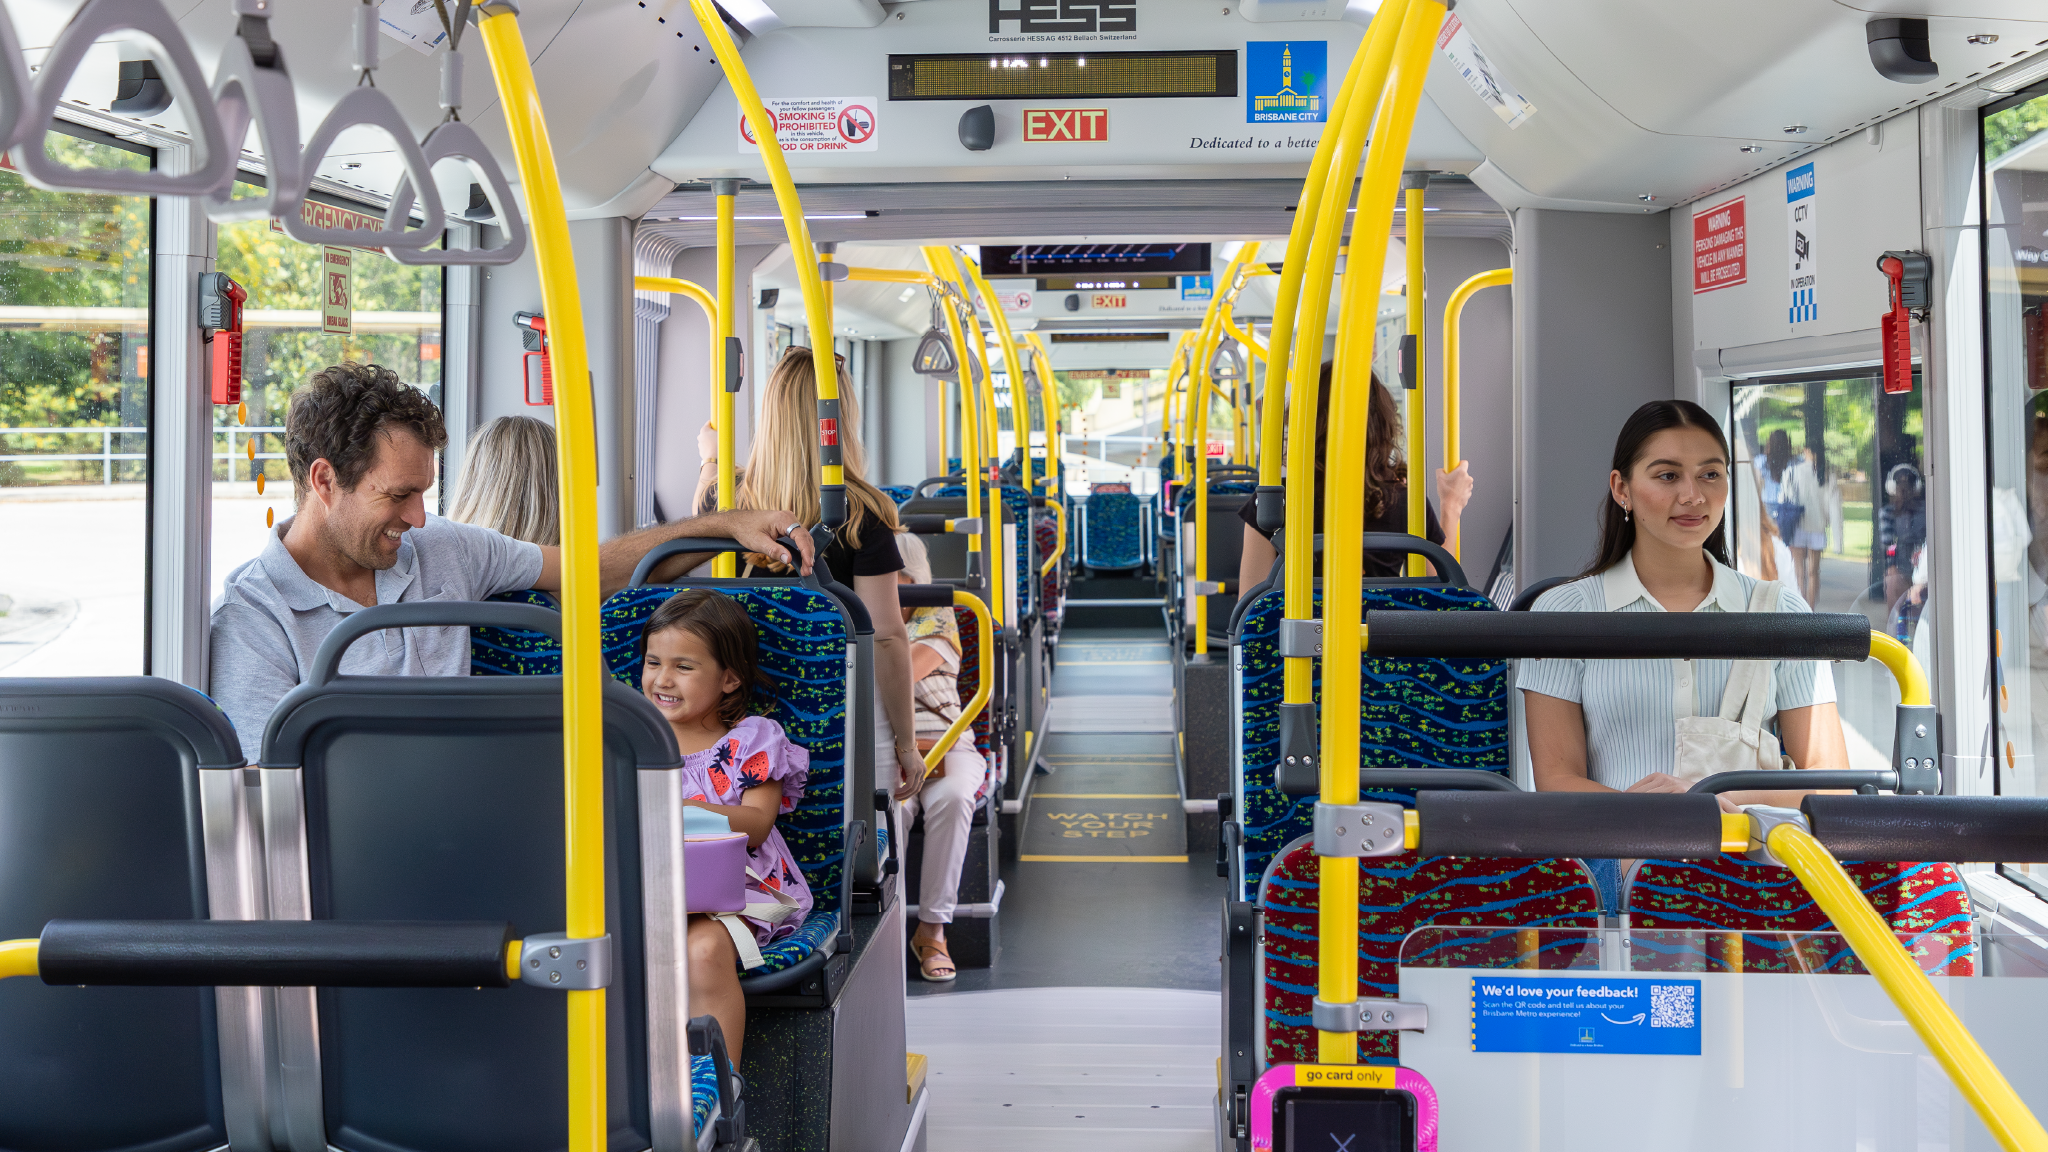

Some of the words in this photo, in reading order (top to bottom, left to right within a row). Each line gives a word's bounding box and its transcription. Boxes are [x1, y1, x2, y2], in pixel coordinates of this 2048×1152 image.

[989, 0, 1136, 33] HESS
[778, 112, 826, 120] SMOKING
[1254, 113, 1298, 121] BRISBANE
[1299, 112, 1318, 120] CITY
[780, 122, 836, 130] PROHIBITED
[1028, 112, 1104, 139] EXIT
[1190, 137, 1254, 148] Dedicated
[1258, 138, 1270, 148] to
[1274, 140, 1282, 148] a
[1788, 172, 1814, 194] WARNING
[1794, 204, 1808, 222] CCTV
[1708, 210, 1730, 232] WARNING
[1696, 237, 1714, 252] PERSONS
[1714, 230, 1734, 248] DAMAGING
[1735, 226, 1744, 240] THIS
[1696, 254, 1712, 268] VEHICLE
[1712, 252, 1718, 264] IN
[1718, 248, 1727, 262] ANY
[1727, 244, 1744, 260] MANNER
[1700, 271, 1710, 284] WILL
[1710, 270, 1716, 282] BE
[1716, 262, 1740, 280] PROSECUTED
[1791, 279, 1795, 289] IN
[1794, 274, 1816, 288] OPERATION
[1094, 296, 1126, 308] EXIT
[1060, 821, 1154, 829] YOUR
[1062, 830, 1150, 838] STEP
[1482, 985, 1514, 996] We'd
[1517, 986, 1543, 997] love
[1546, 988, 1574, 999] your
[1576, 986, 1638, 998] feedback!
[1306, 1072, 1322, 1082] go
[1326, 1070, 1353, 1080] card
[1357, 1071, 1382, 1082] only
